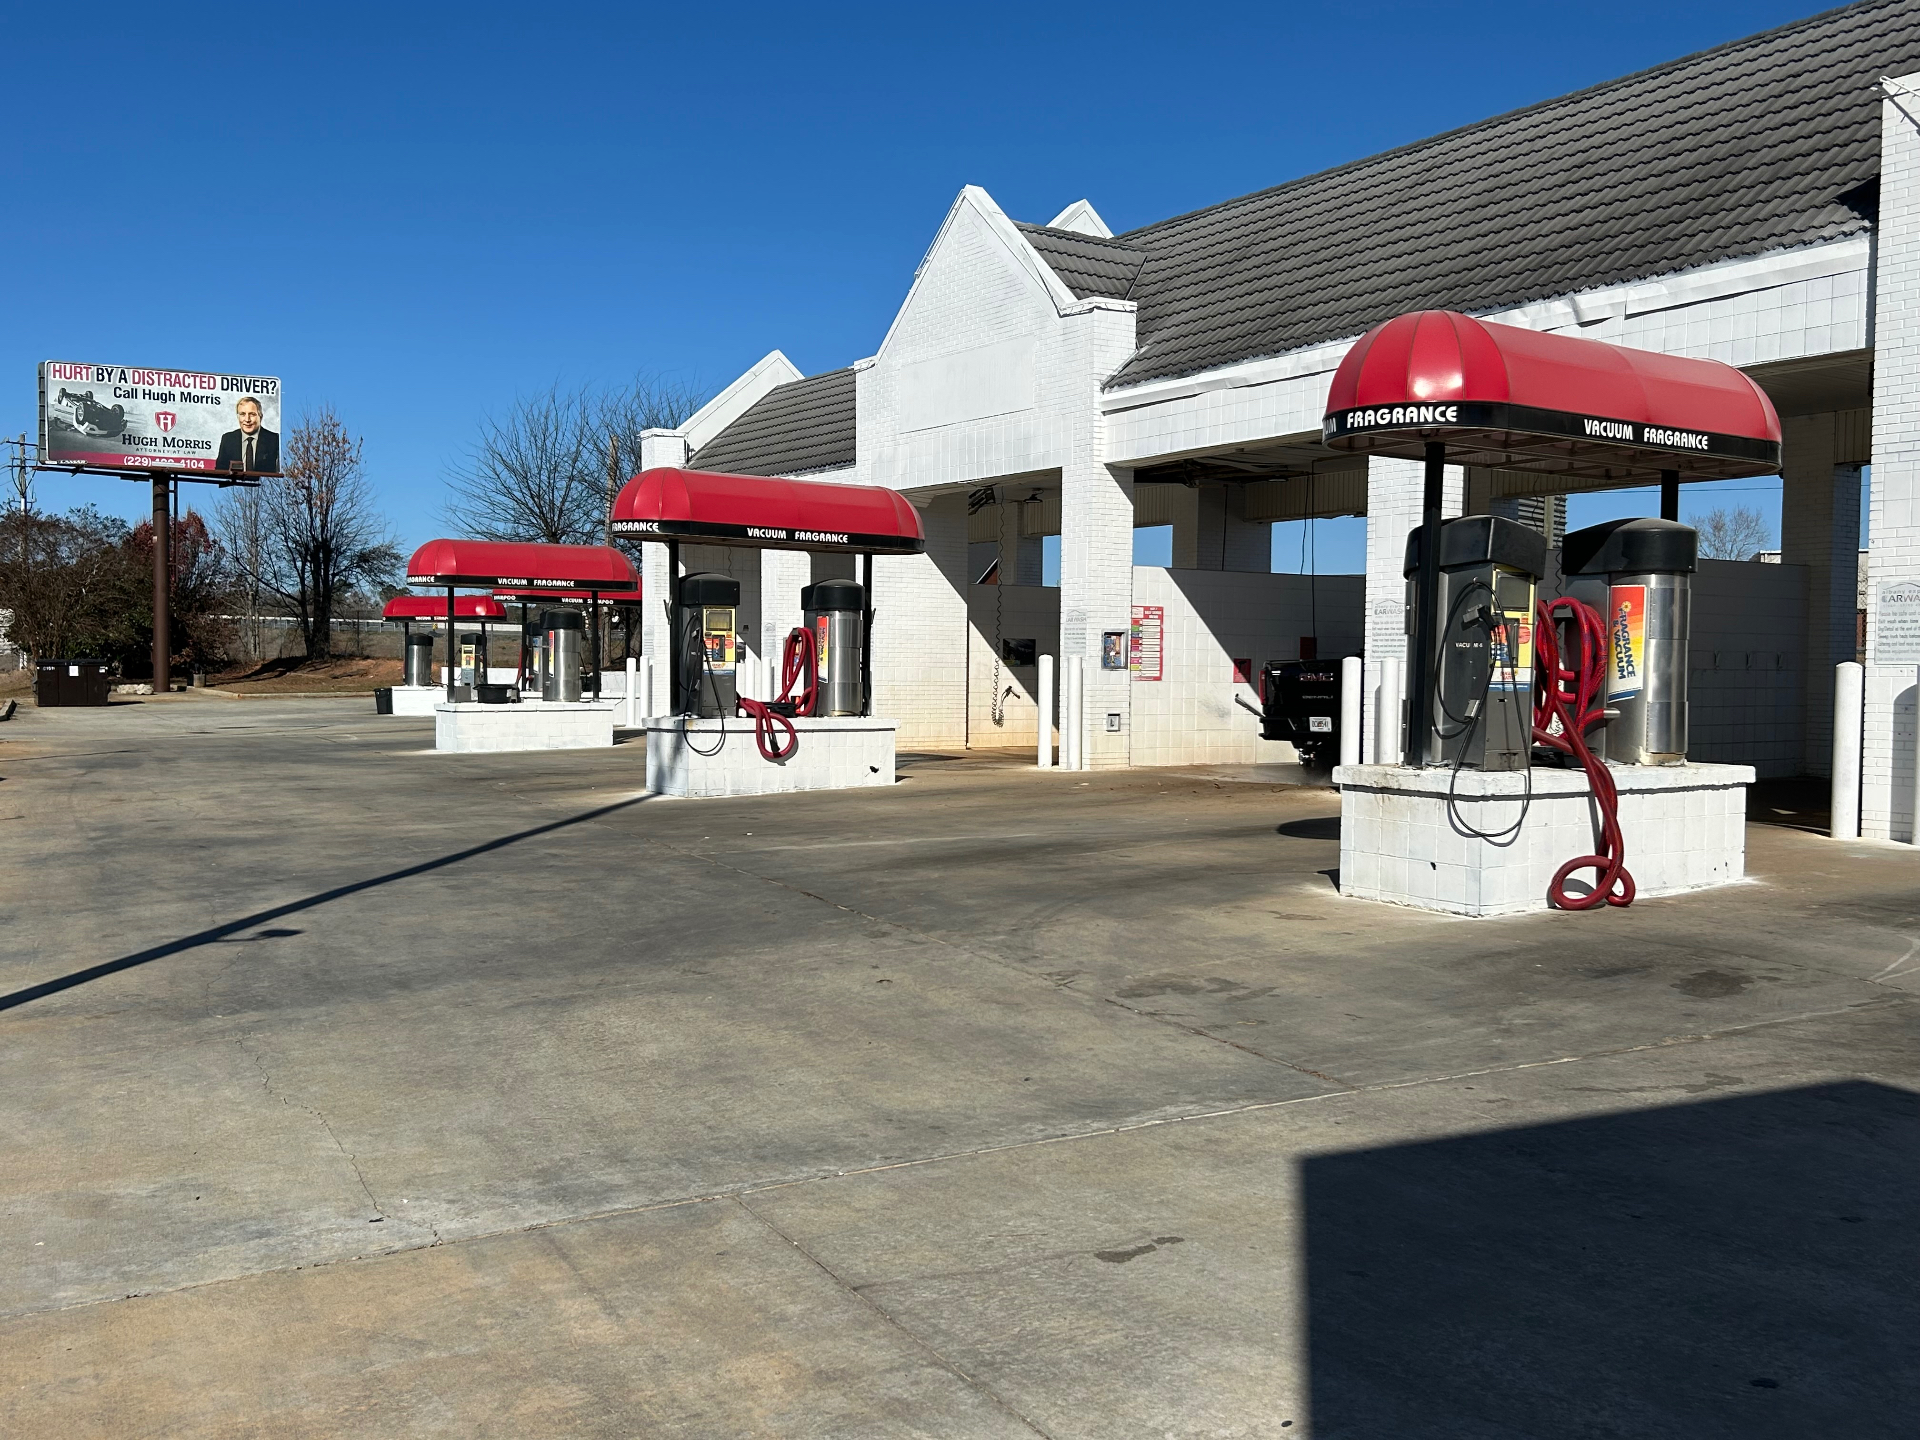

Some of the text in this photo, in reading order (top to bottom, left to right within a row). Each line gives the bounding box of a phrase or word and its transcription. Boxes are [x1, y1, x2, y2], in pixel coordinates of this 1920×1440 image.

[52, 364, 277, 395] HURT BY A DISTRACTED DRIVER?
[113, 386, 221, 405] Call Hugh Morris
[158, 414, 174, 432] H
[1347, 406, 1458, 428] FRAGRANCE
[121, 433, 212, 450] HUGH MORRIS
[1584, 418, 1709, 450] VACUUM FRAGRANCE
[123, 455, 152, 467] (229)
[746, 527, 849, 543] VACUUM FRAGRANCE
[497, 577, 575, 588] VACUUM FRAGRANCE
[1618, 606, 1637, 679] FRAGRANCE
[1613, 628, 1627, 680] VACUUM
[1300, 672, 1334, 681] GMC
